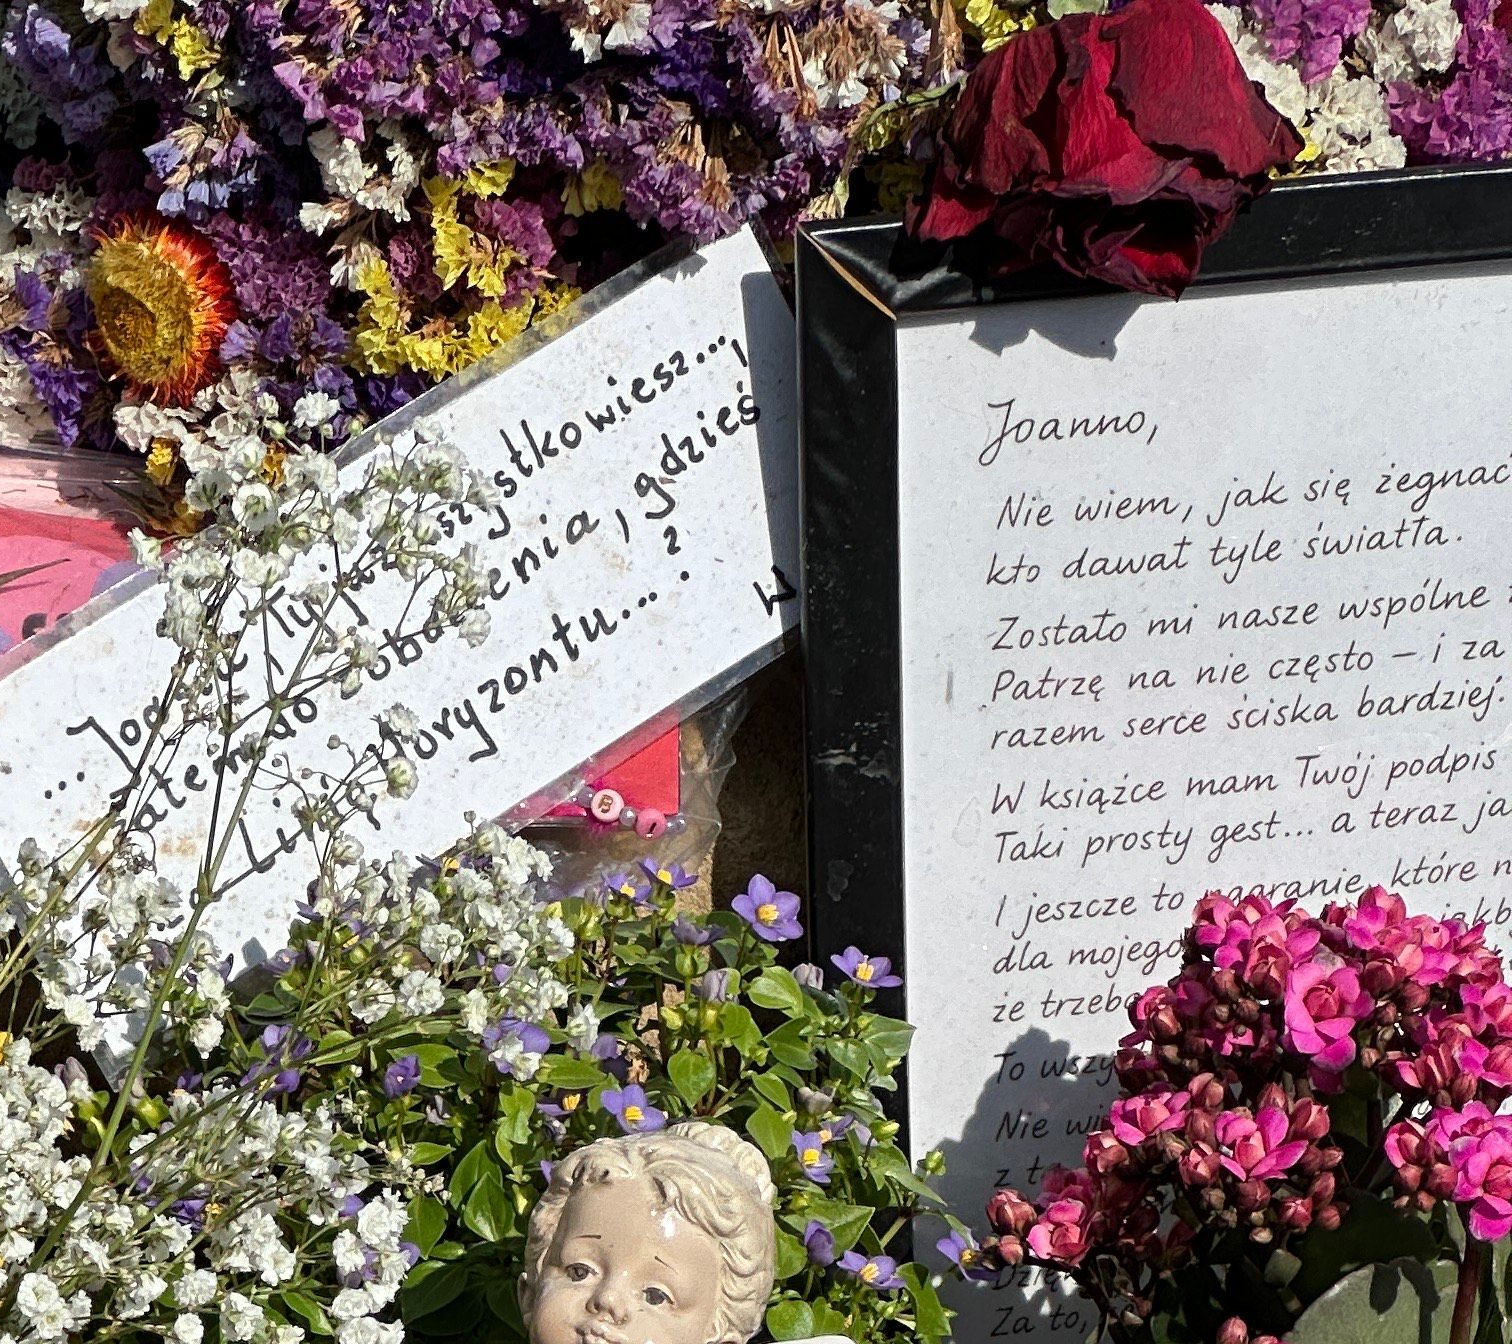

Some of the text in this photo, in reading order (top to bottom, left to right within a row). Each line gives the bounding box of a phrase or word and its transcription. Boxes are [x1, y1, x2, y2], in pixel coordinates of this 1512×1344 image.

[634, 380, 761, 519] gdzieś
[979, 398, 1158, 466] Joanno,
[997, 492, 1054, 529] Nie
[1074, 490, 1193, 523] wiem,
[1206, 470, 1289, 527] jak
[1303, 468, 1351, 506] się
[986, 551, 1041, 585] kto
[1209, 529, 1283, 584] tyle
[1302, 514, 1464, 559] światła.
[991, 608, 1128, 651] Zostało
[1146, 603, 1199, 636] mi
[1217, 601, 1321, 630] nasze
[1338, 577, 1492, 630] wspólne
[991, 666, 1105, 702] Patrzę
[1128, 667, 1177, 690] na
[1195, 652, 1251, 685] nie
[1268, 640, 1375, 684] często
[1431, 632, 1446, 664] i
[1461, 638, 1506, 662] za
[990, 675, 1506, 750] razem serce ściska bardziej.
[990, 741, 1498, 815] W książce mam Twój podpis
[994, 826, 1066, 864] Taki
[1081, 818, 1194, 869] prosty
[1207, 809, 1314, 864] gest...
[1330, 811, 1357, 834] a
[1369, 799, 1459, 831] teraz
[995, 894, 1007, 928] I
[1011, 892, 1138, 940] jeszcze
[1151, 882, 1185, 912] to
[1390, 851, 1480, 889] które
[993, 940, 1054, 975] dla
[1068, 934, 1184, 979] mojego
[992, 992, 1026, 1023] że
[994, 1051, 1025, 1084] To
[996, 1108, 1050, 1142] Nie
[990, 1304, 1088, 1338] Za to,
